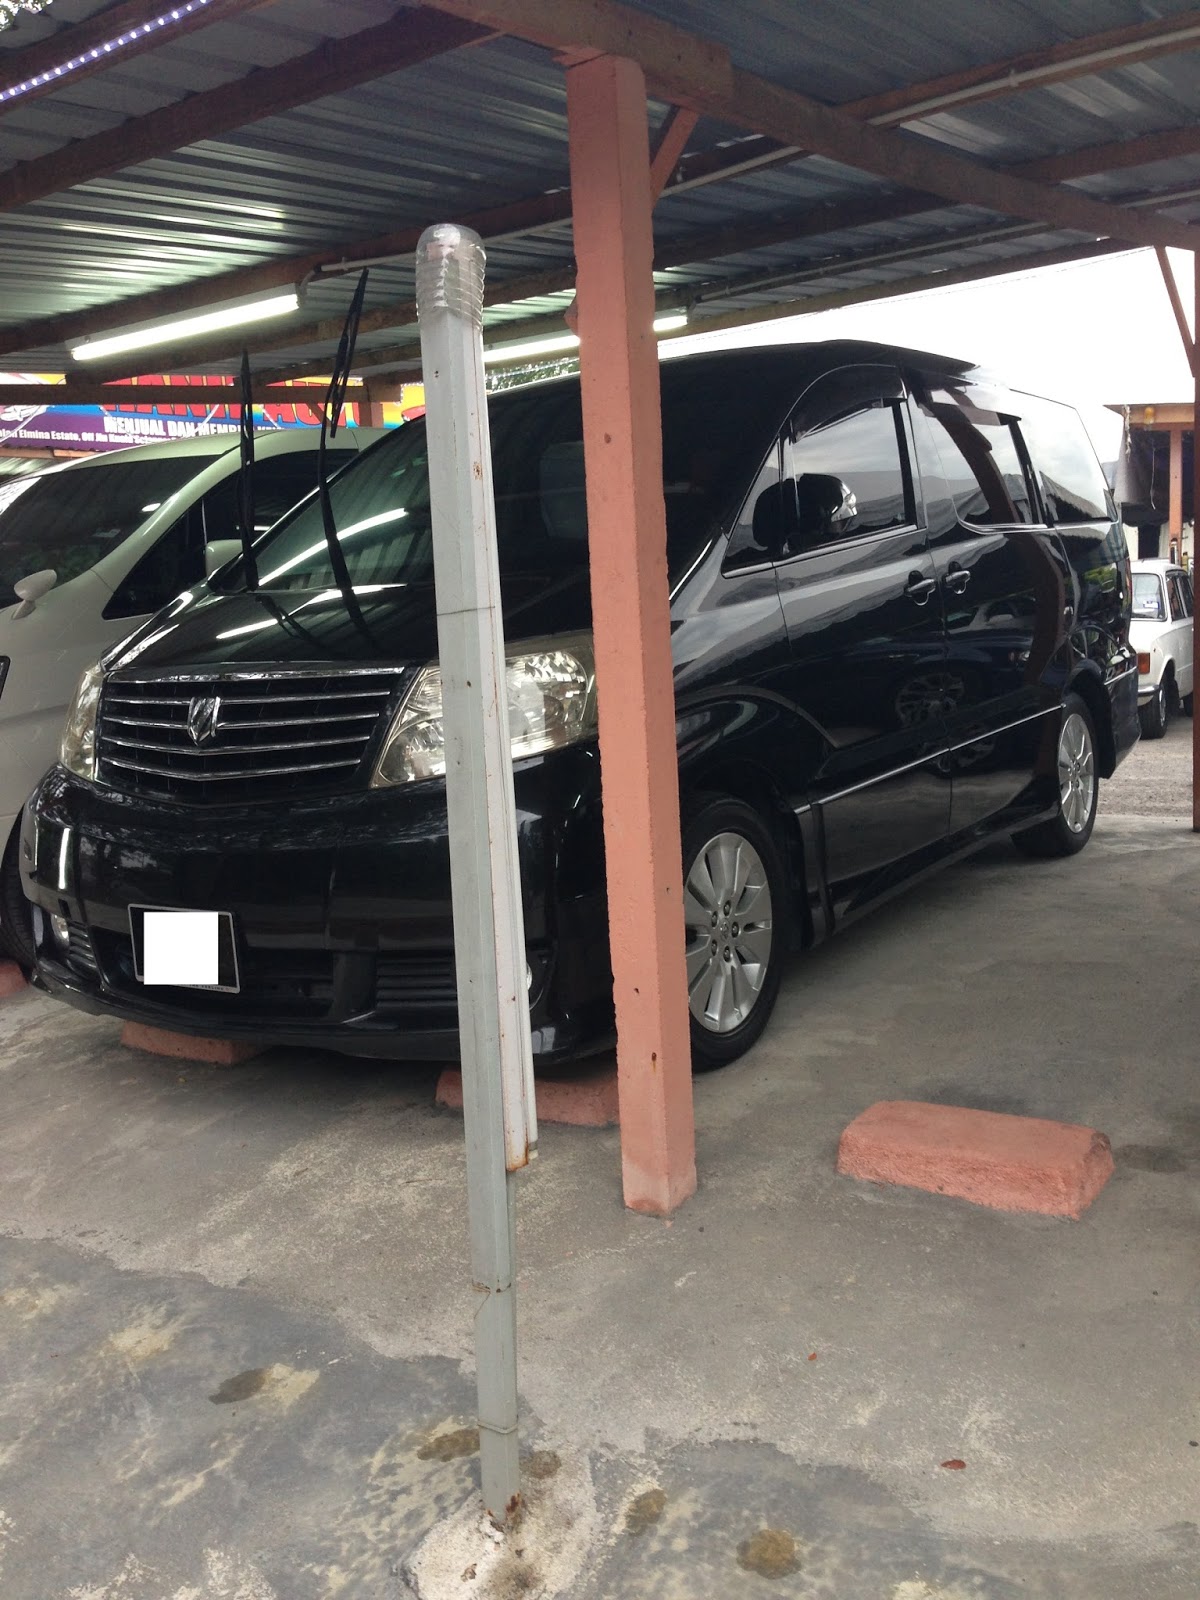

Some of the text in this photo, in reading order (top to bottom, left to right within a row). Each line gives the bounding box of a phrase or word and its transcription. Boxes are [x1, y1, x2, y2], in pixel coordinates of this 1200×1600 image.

[19, 429, 50, 440] Elmina
[51, 430, 81, 442] Estate,
[103, 416, 166, 436] MENJUAL
[167, 420, 196, 438] DAN
